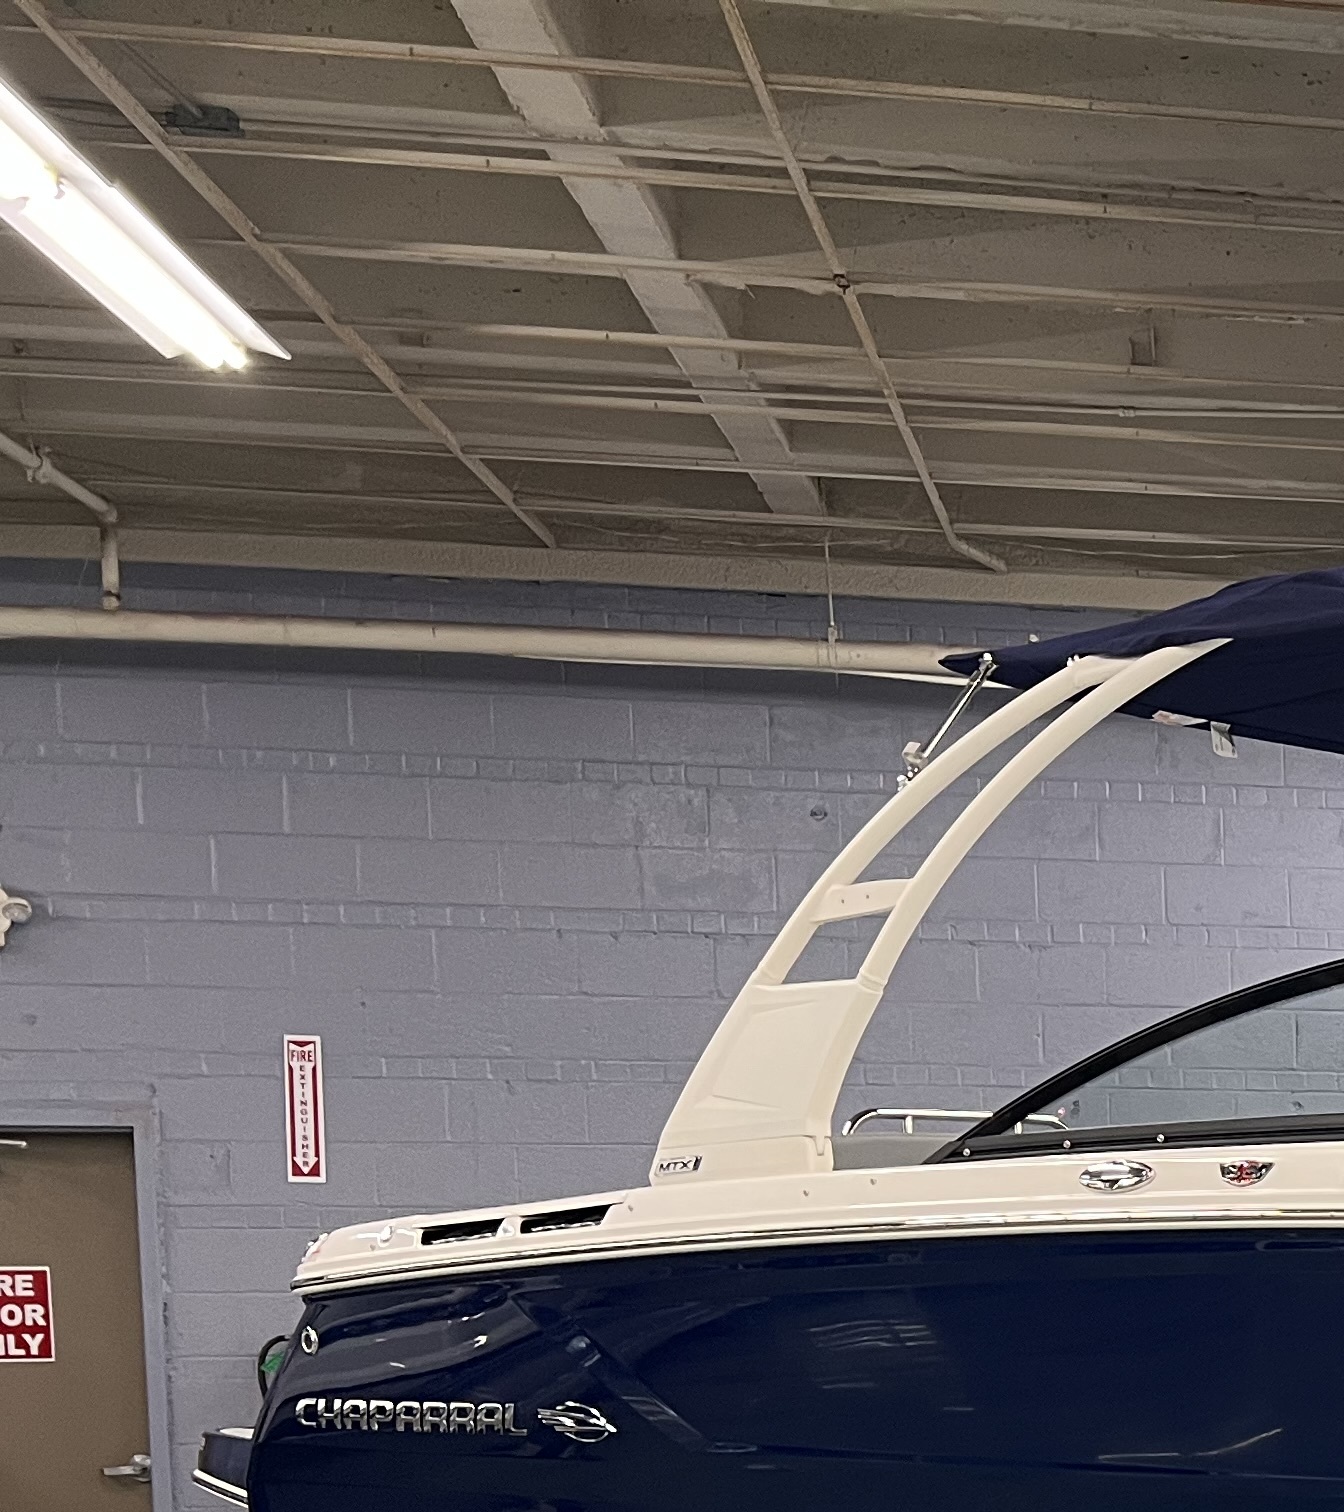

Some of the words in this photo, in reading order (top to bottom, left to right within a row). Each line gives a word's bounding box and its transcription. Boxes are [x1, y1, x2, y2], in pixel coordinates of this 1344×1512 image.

[290, 1049, 314, 1063] FIRE
[299, 1064, 310, 1168] EXTINGUISHER
[0, 1333, 45, 1356] LY
[295, 1397, 528, 1436] CHAPARRAL
